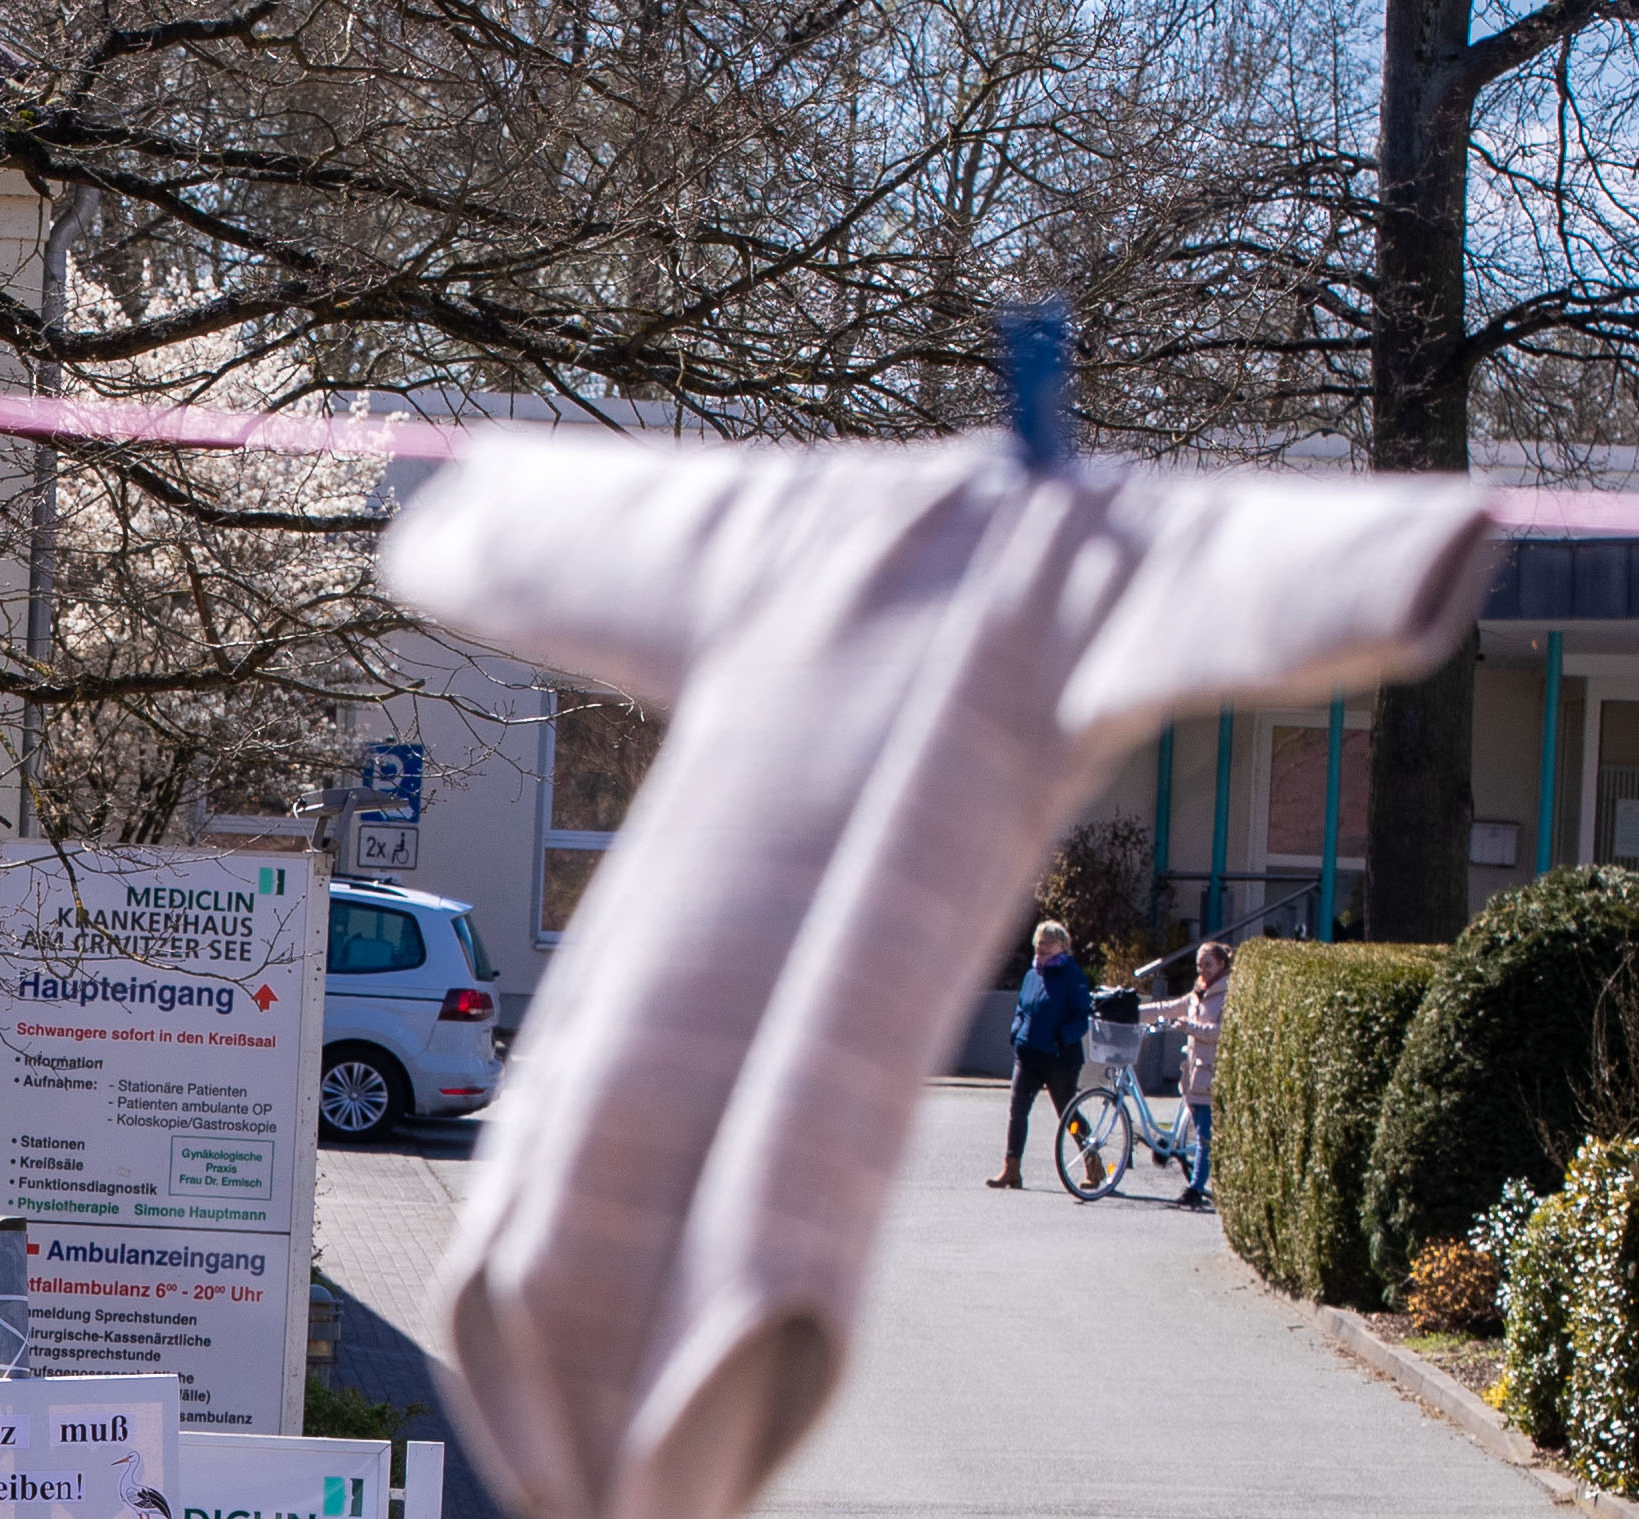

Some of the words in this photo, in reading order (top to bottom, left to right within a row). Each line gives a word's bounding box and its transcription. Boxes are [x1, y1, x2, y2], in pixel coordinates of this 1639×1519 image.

[366, 837, 386, 858] 2x
[126, 886, 254, 913] MEDICLIN
[57, 907, 253, 937] KRANKENHAUS
[209, 939, 252, 963] SEE
[19, 971, 234, 1015] Haupteingang
[17, 1023, 108, 1043] Schwangere
[112, 1028, 155, 1043] sofort
[159, 1029, 172, 1043] in
[177, 1030, 203, 1045] den
[208, 1032, 276, 1047] Kreißsaal
[24, 1055, 103, 1070] Information
[23, 1075, 97, 1091] Aufnahme:
[118, 1080, 184, 1096] Stationäre
[188, 1084, 247, 1098] Patienten
[117, 1097, 177, 1112] Patienten
[181, 1100, 248, 1116] ambulante
[252, 1104, 273, 1116] OP
[116, 1114, 277, 1133] Koloskopie/Gastroskopie
[20, 1136, 85, 1151] Stationen
[20, 1156, 84, 1171] Kreißsäle
[181, 1148, 262, 1163] Gynäkologische
[205, 1163, 237, 1175] Praxis
[18, 1177, 157, 1196] Funktionsdiagnostik
[179, 1174, 202, 1187] Frau
[204, 1175, 218, 1188] Dr.
[221, 1176, 262, 1189] Ermisch
[17, 1198, 119, 1215] Physiotherapie
[134, 1203, 185, 1218] Simone
[189, 1205, 266, 1222] Hauptmann
[46, 1240, 266, 1276] Ambulanzeingang
[27, 1277, 150, 1298] tfallambulanz
[231, 1287, 264, 1302] Uhr
[28, 1306, 91, 1324] meldung
[95, 1309, 197, 1326] Sprechstunden
[30, 1327, 211, 1348] irurgische-Kassenärztliche
[29, 1345, 161, 1362] rtragssprechstunde
[179, 1411, 252, 1425] sambulanz
[59, 1415, 128, 1443] muß
